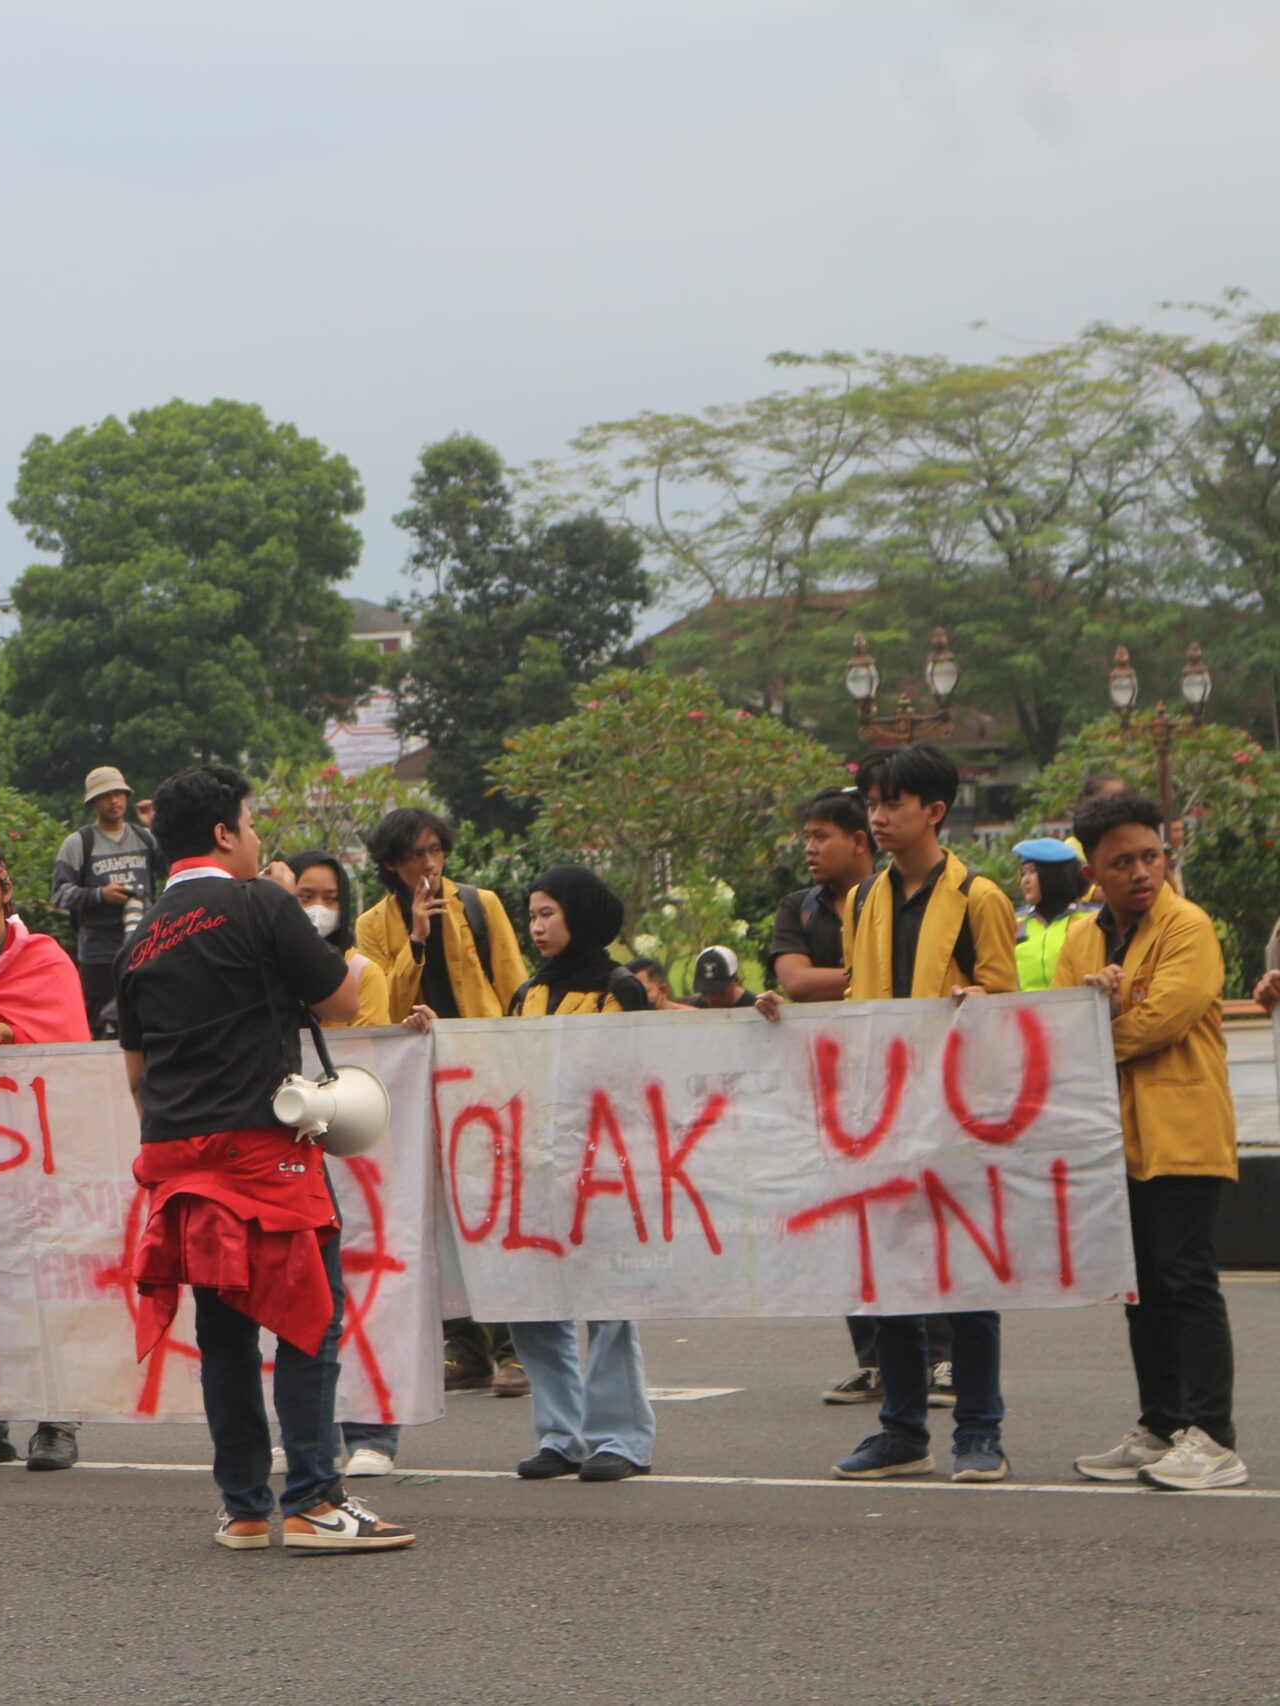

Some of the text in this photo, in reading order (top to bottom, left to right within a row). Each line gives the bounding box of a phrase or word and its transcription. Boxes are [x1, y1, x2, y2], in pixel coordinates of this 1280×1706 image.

[92, 855, 147, 876] CHAMPION
[109, 871, 136, 884] USA
[780, 1156, 1075, 1304] TNI
